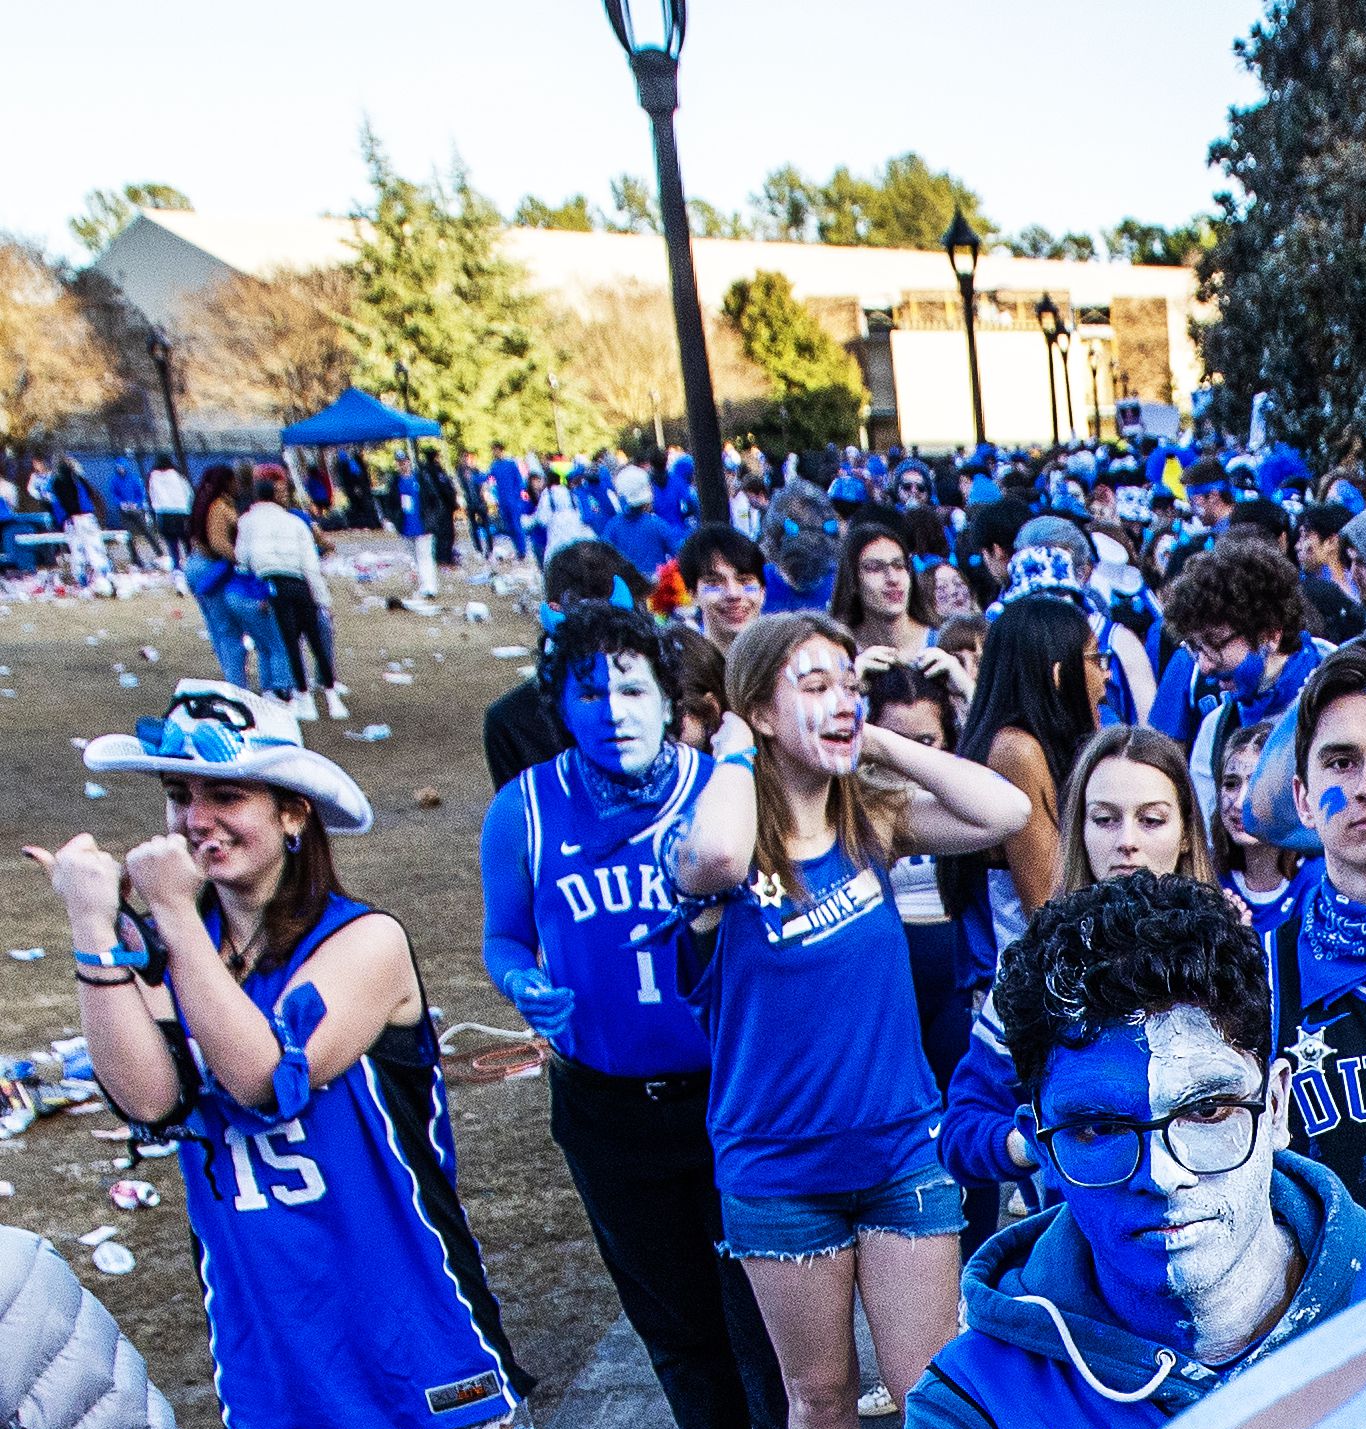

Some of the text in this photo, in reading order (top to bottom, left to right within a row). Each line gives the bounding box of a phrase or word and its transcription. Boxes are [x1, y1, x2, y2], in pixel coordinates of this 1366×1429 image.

[556, 863, 680, 923] DUK
[629, 923, 662, 1004] 1
[223, 1117, 327, 1212] 15
